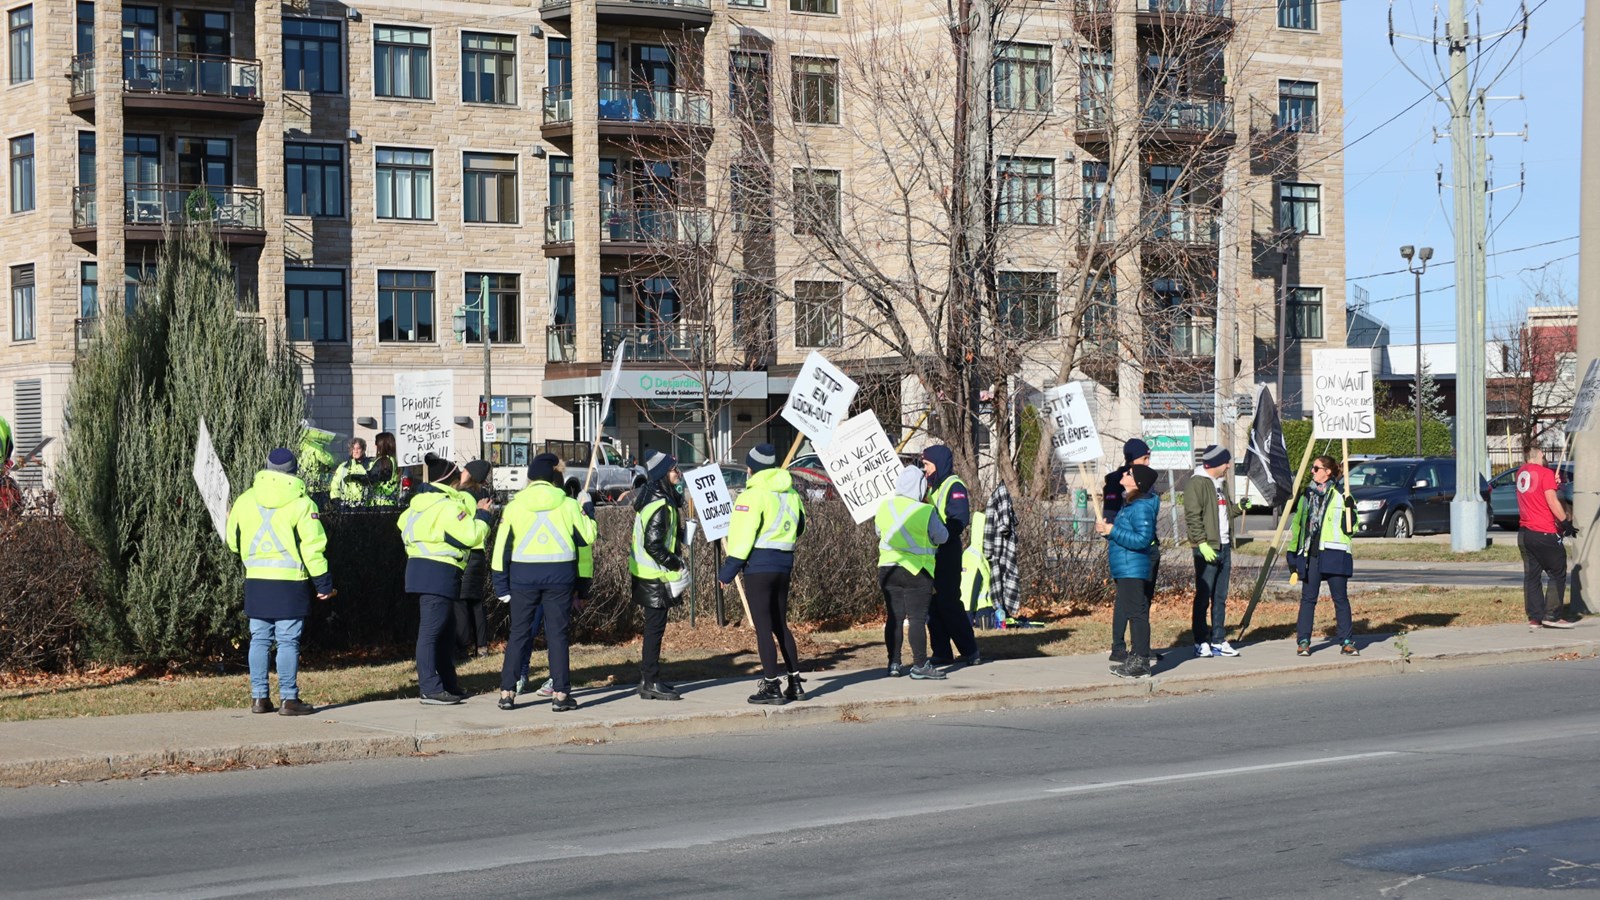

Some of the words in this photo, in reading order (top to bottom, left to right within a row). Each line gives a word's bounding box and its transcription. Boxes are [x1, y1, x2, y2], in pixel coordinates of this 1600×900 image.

[655, 378, 701, 389] Desjardins
[812, 366, 844, 393] STTP
[1316, 374, 1336, 390] ON
[1339, 370, 1369, 392] VAUT
[812, 386, 829, 406] EN
[416, 411, 430, 420] AUX
[792, 393, 832, 424] LOCK-OUT
[1056, 413, 1073, 428] EN
[1318, 411, 1371, 434] PEANUTS
[408, 434, 424, 443] PAS
[427, 430, 451, 442] JUSTE
[417, 442, 434, 451] AUX
[830, 454, 849, 472] ON
[851, 432, 877, 459] VEUT
[835, 471, 855, 486] UNE
[857, 449, 893, 477] ENTENTE
[694, 474, 716, 490] STTP
[705, 490, 718, 504] EN
[702, 502, 733, 520] LOCK-OUT
